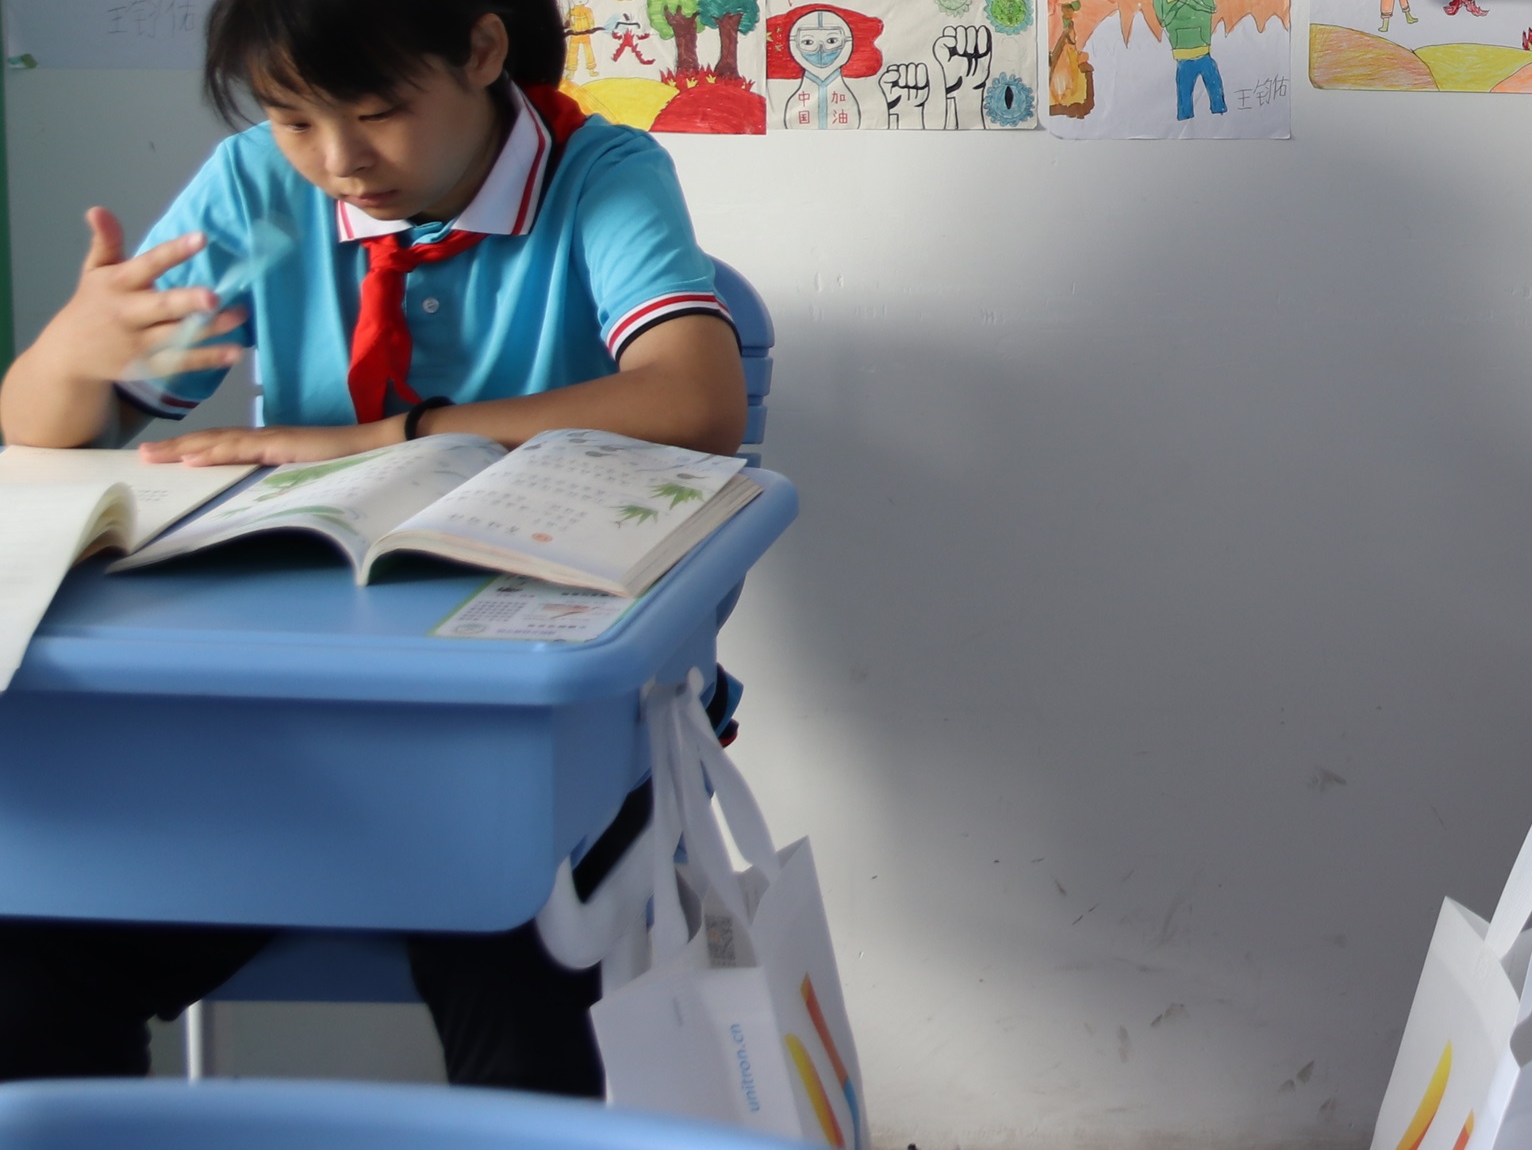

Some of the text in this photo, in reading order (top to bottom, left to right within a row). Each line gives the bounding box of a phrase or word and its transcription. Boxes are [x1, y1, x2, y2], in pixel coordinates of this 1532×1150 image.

[798, 91, 811, 124] 中国
[831, 90, 848, 124] 加油
[729, 1024, 760, 1114] unitron.cn
